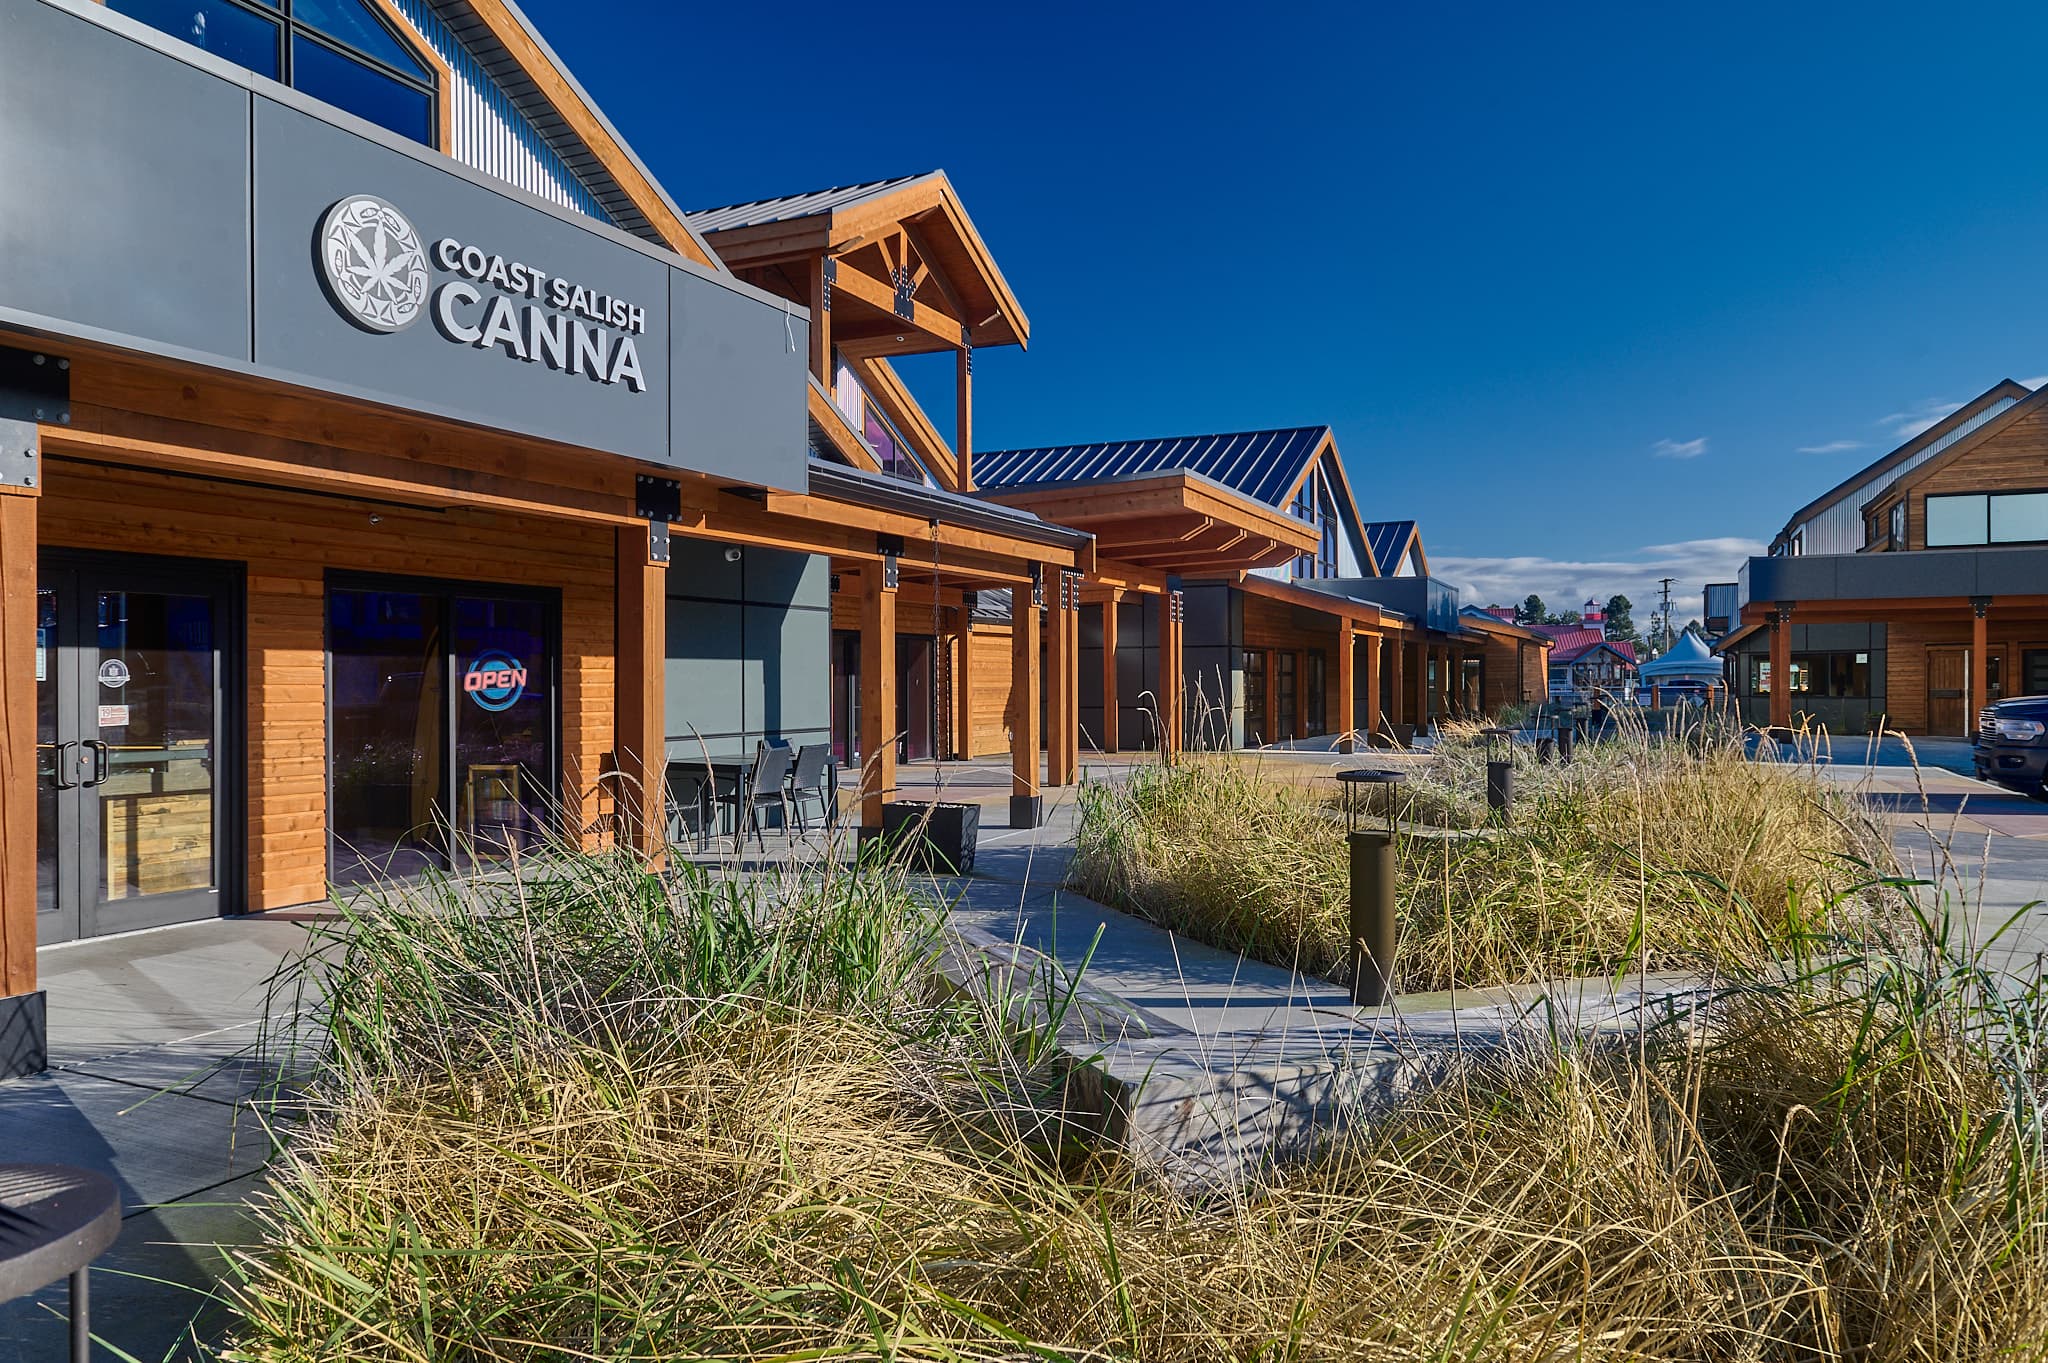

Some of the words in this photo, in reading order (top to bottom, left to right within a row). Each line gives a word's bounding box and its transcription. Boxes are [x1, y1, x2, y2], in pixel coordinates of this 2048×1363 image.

[438, 238, 546, 298] COAST
[552, 278, 645, 334] SALISH
[438, 281, 647, 392] CANNA
[464, 668, 527, 692] OPEN
